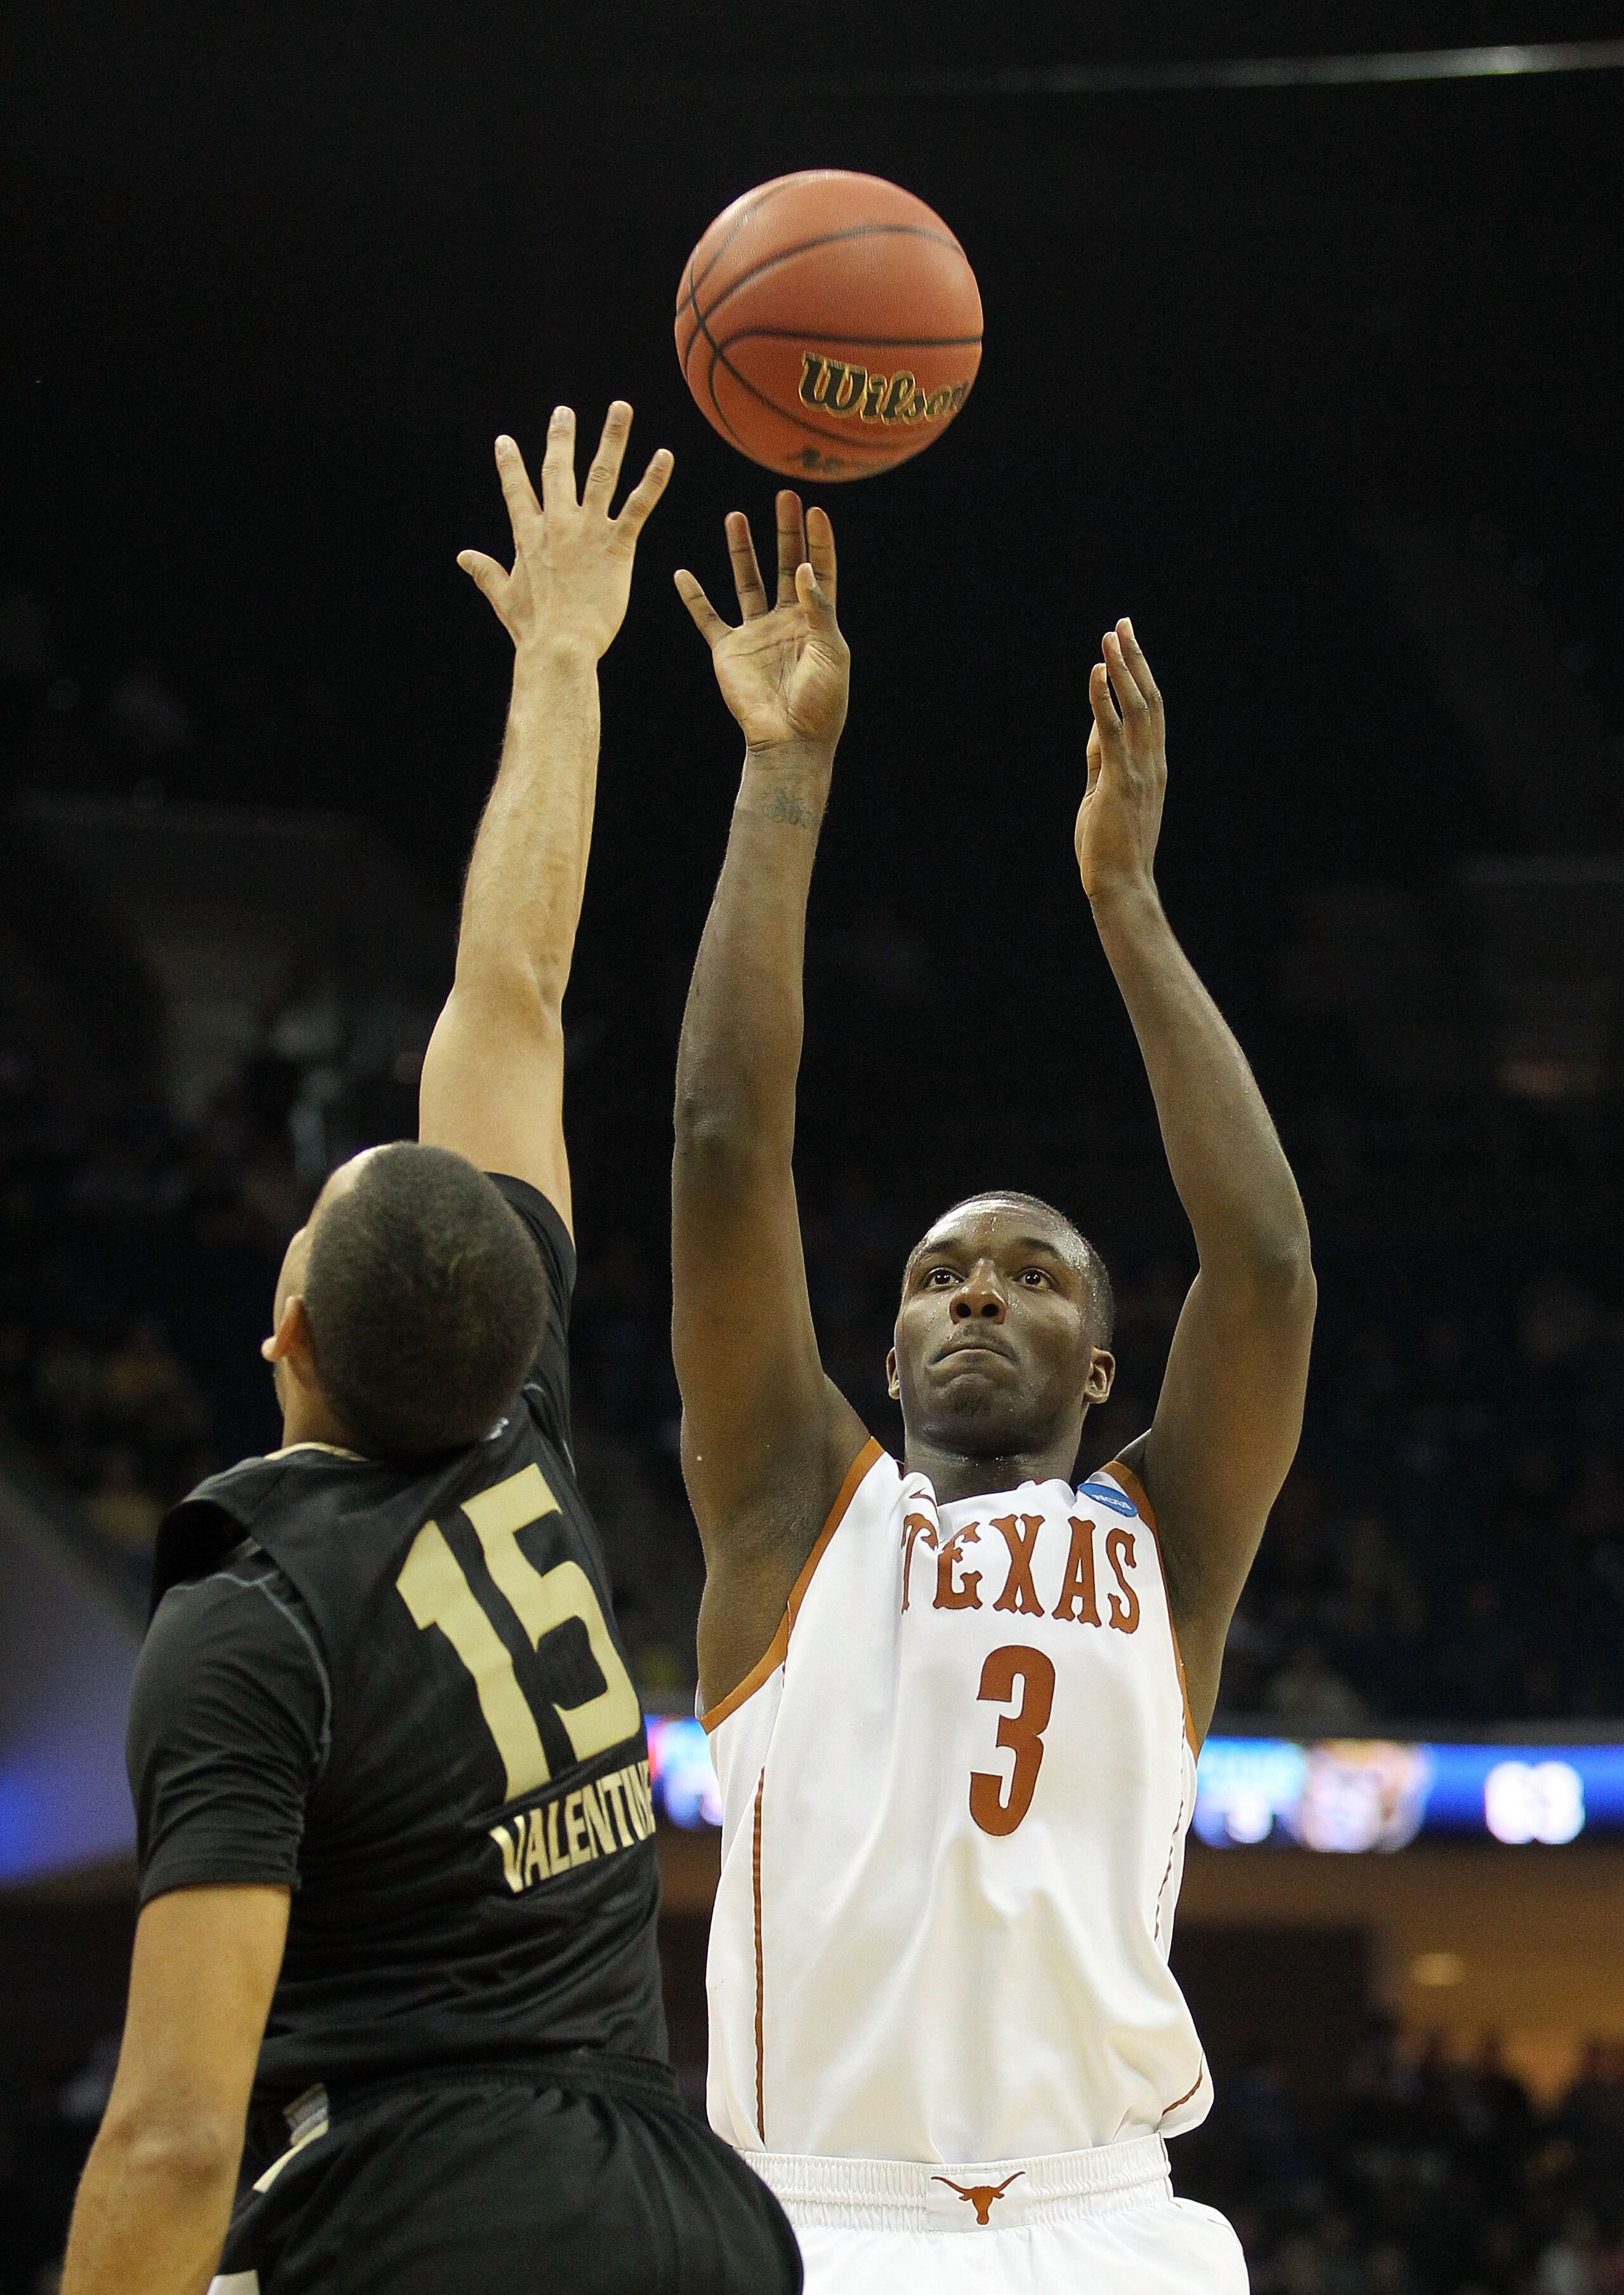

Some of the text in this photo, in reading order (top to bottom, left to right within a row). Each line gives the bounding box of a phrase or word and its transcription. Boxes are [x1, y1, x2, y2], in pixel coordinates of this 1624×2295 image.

[396, 1462, 641, 1803] 15
[901, 1513, 1140, 1634] TEXAS
[969, 1645, 1056, 1836] 3
